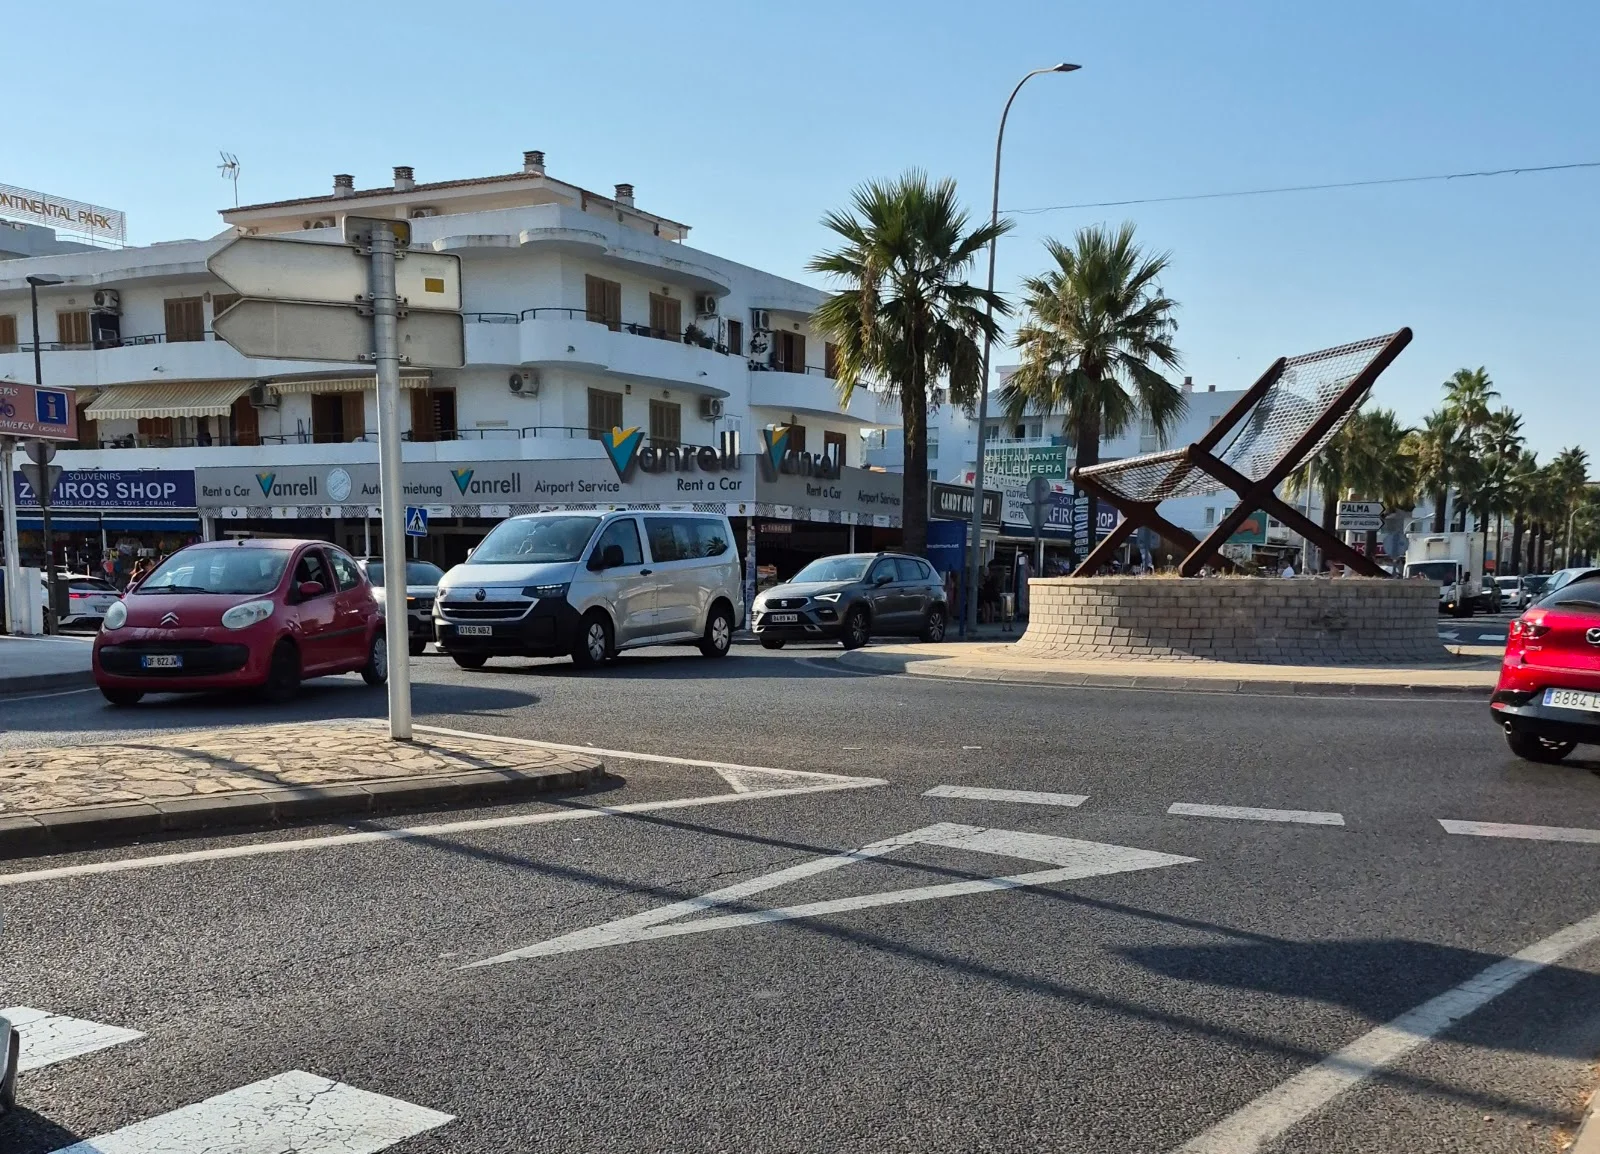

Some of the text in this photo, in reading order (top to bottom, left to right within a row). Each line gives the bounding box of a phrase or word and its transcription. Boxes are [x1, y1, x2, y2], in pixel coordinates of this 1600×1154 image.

[78, 210, 112, 229] PARK
[600, 425, 741, 484] Vanrell
[68, 472, 121, 481] SOUVENIRS
[450, 467, 521, 497] Vanrell
[677, 477, 742, 491] Rent a Car
[20, 482, 177, 499] ZIROS SHOP
[202, 485, 250, 497] Rent a Car
[255, 471, 317, 499] Vanrell
[534, 479, 620, 496] Airport Service
[806, 483, 842, 499] Rent a Car
[857, 489, 901, 506] Airport Service
[940, 492, 961, 512] CANDY
[1010, 511, 1024, 519] GIFTS
[1341, 504, 1370, 513] PALMA
[460, 626, 477, 634] 0169
[1554, 691, 1587, 706] 8884
